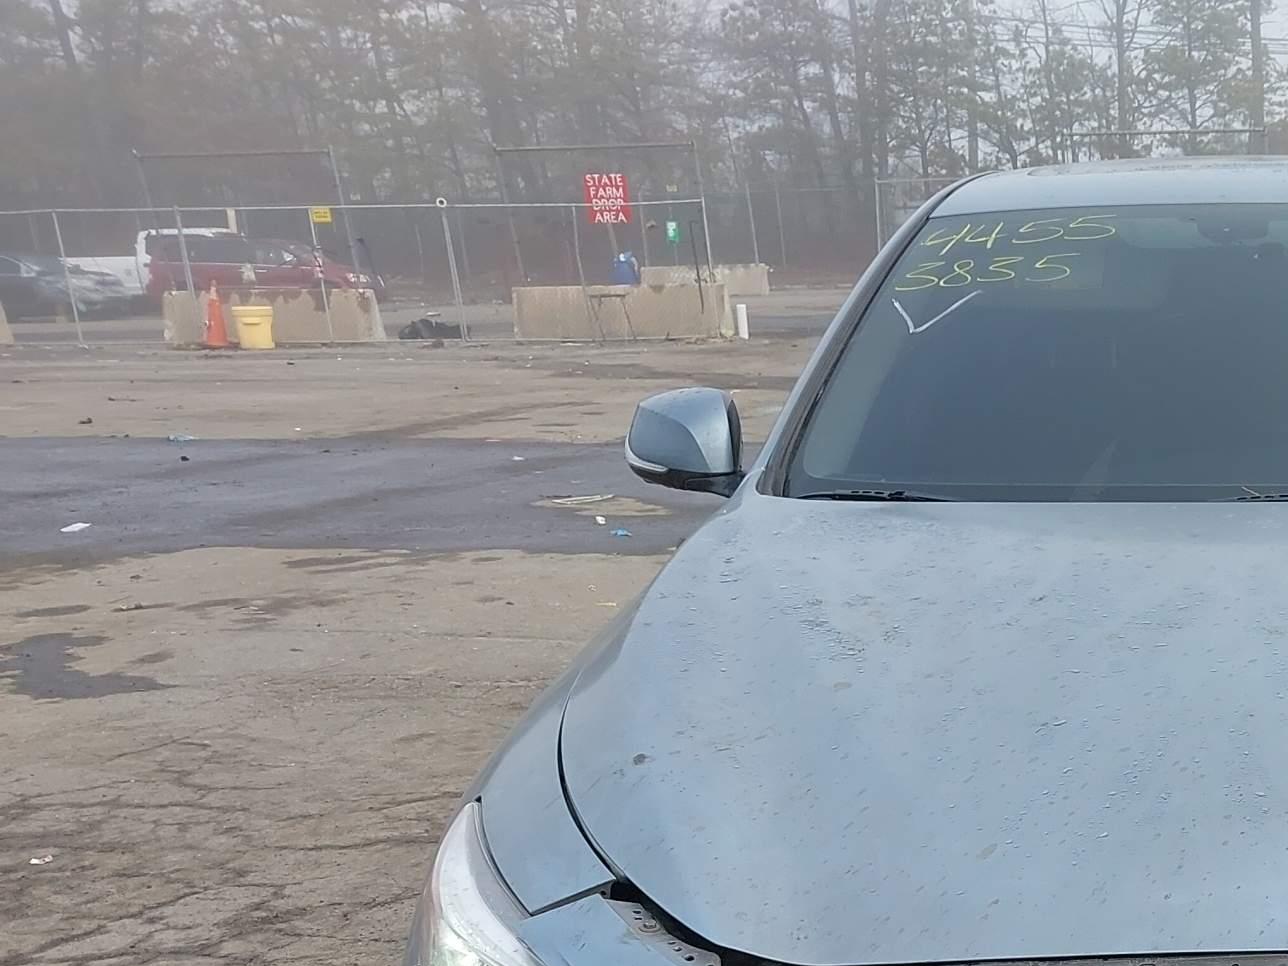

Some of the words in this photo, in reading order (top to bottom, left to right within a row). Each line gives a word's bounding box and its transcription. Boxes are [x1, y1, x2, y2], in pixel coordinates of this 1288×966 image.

[585, 174, 624, 186] STATE
[589, 186, 624, 198] FARM
[592, 198, 625, 211] DROP
[595, 211, 627, 224] AREA
[920, 214, 1118, 256] 4455
[895, 252, 1081, 291] 3835
